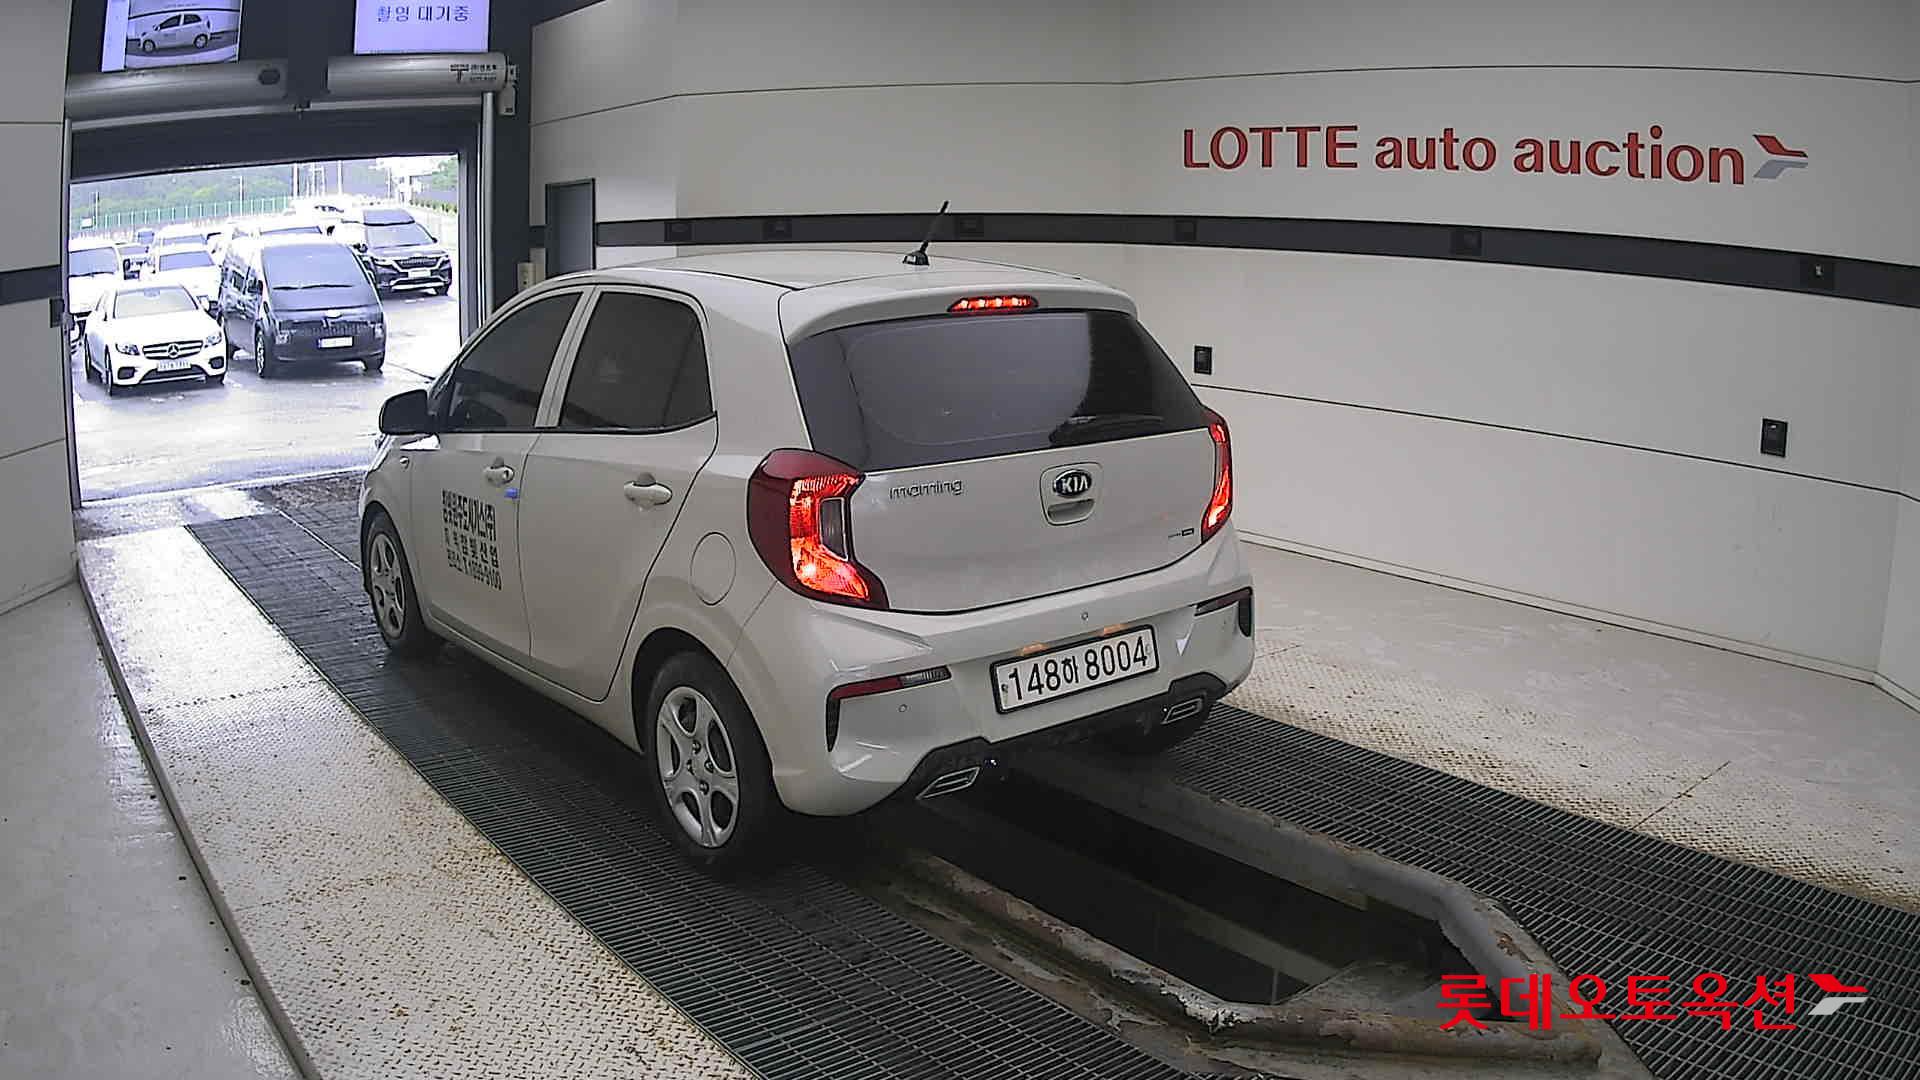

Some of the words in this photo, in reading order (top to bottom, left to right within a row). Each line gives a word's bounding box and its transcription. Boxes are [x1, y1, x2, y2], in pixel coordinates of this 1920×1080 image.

[418, 5, 469, 22] 대기중
[1183, 125, 1359, 170] LOTTE
[1375, 127, 1498, 172] auto
[1512, 124, 1745, 186] auction
[889, 479, 963, 500] morning
[1060, 474, 1090, 494] KIA
[1008, 655, 1080, 700] 148하
[1084, 636, 1148, 681] 8004
